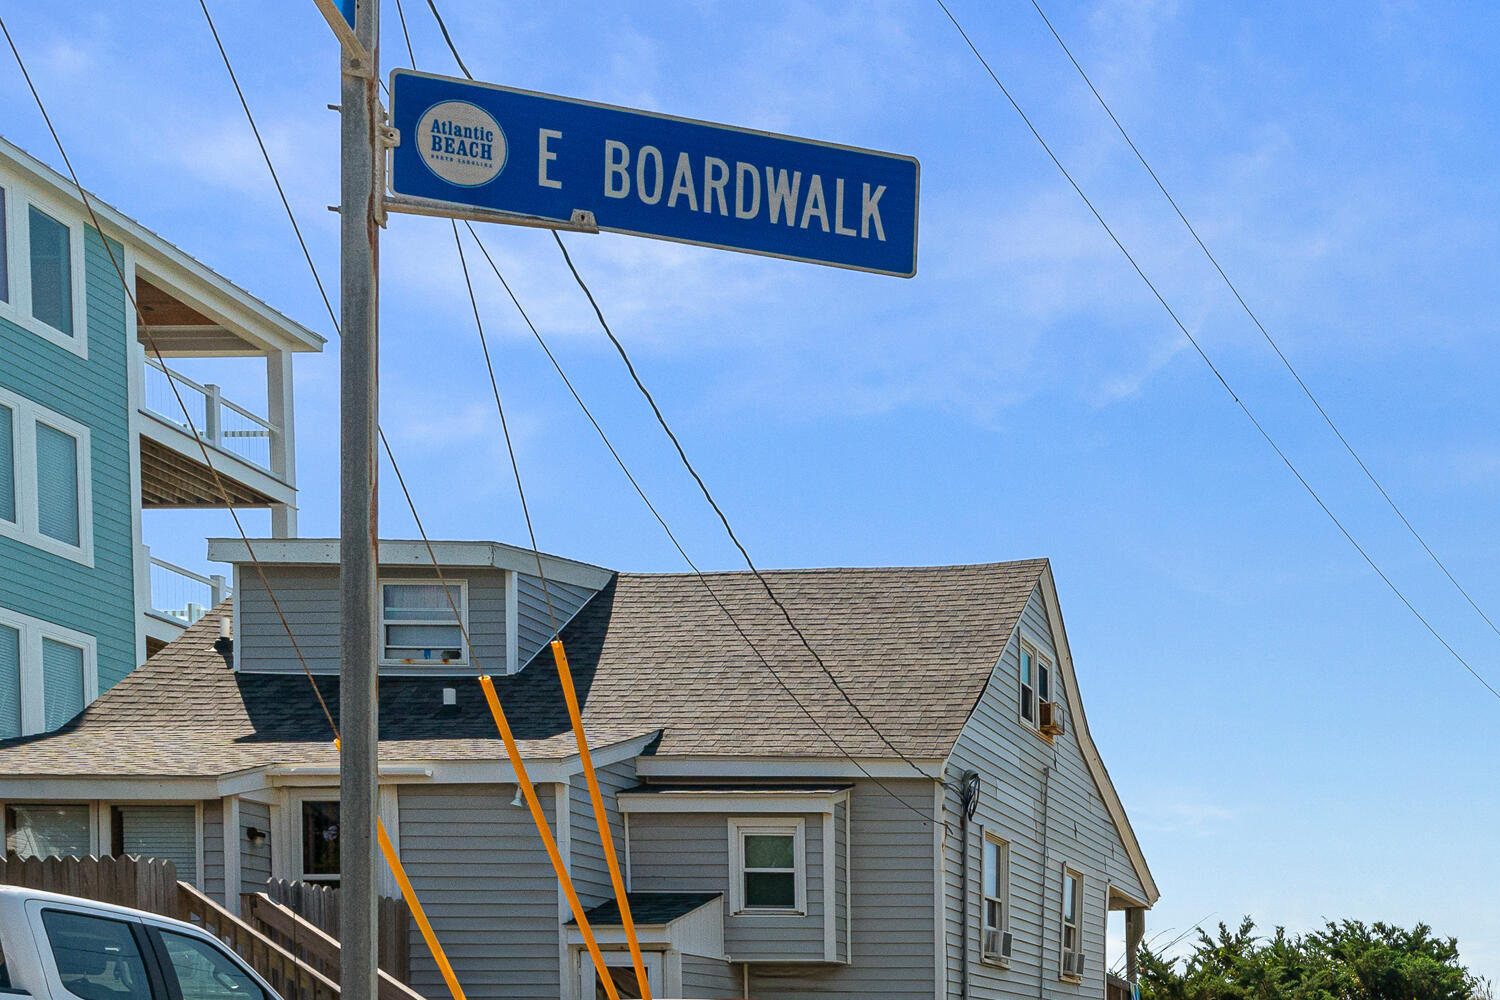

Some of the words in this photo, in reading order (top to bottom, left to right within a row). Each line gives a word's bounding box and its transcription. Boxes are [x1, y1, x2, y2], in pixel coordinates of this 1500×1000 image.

[430, 118, 494, 142] Atlantic
[431, 134, 493, 160] BEACH
[538, 128, 563, 189] E
[604, 139, 887, 242] BOARDWALK
